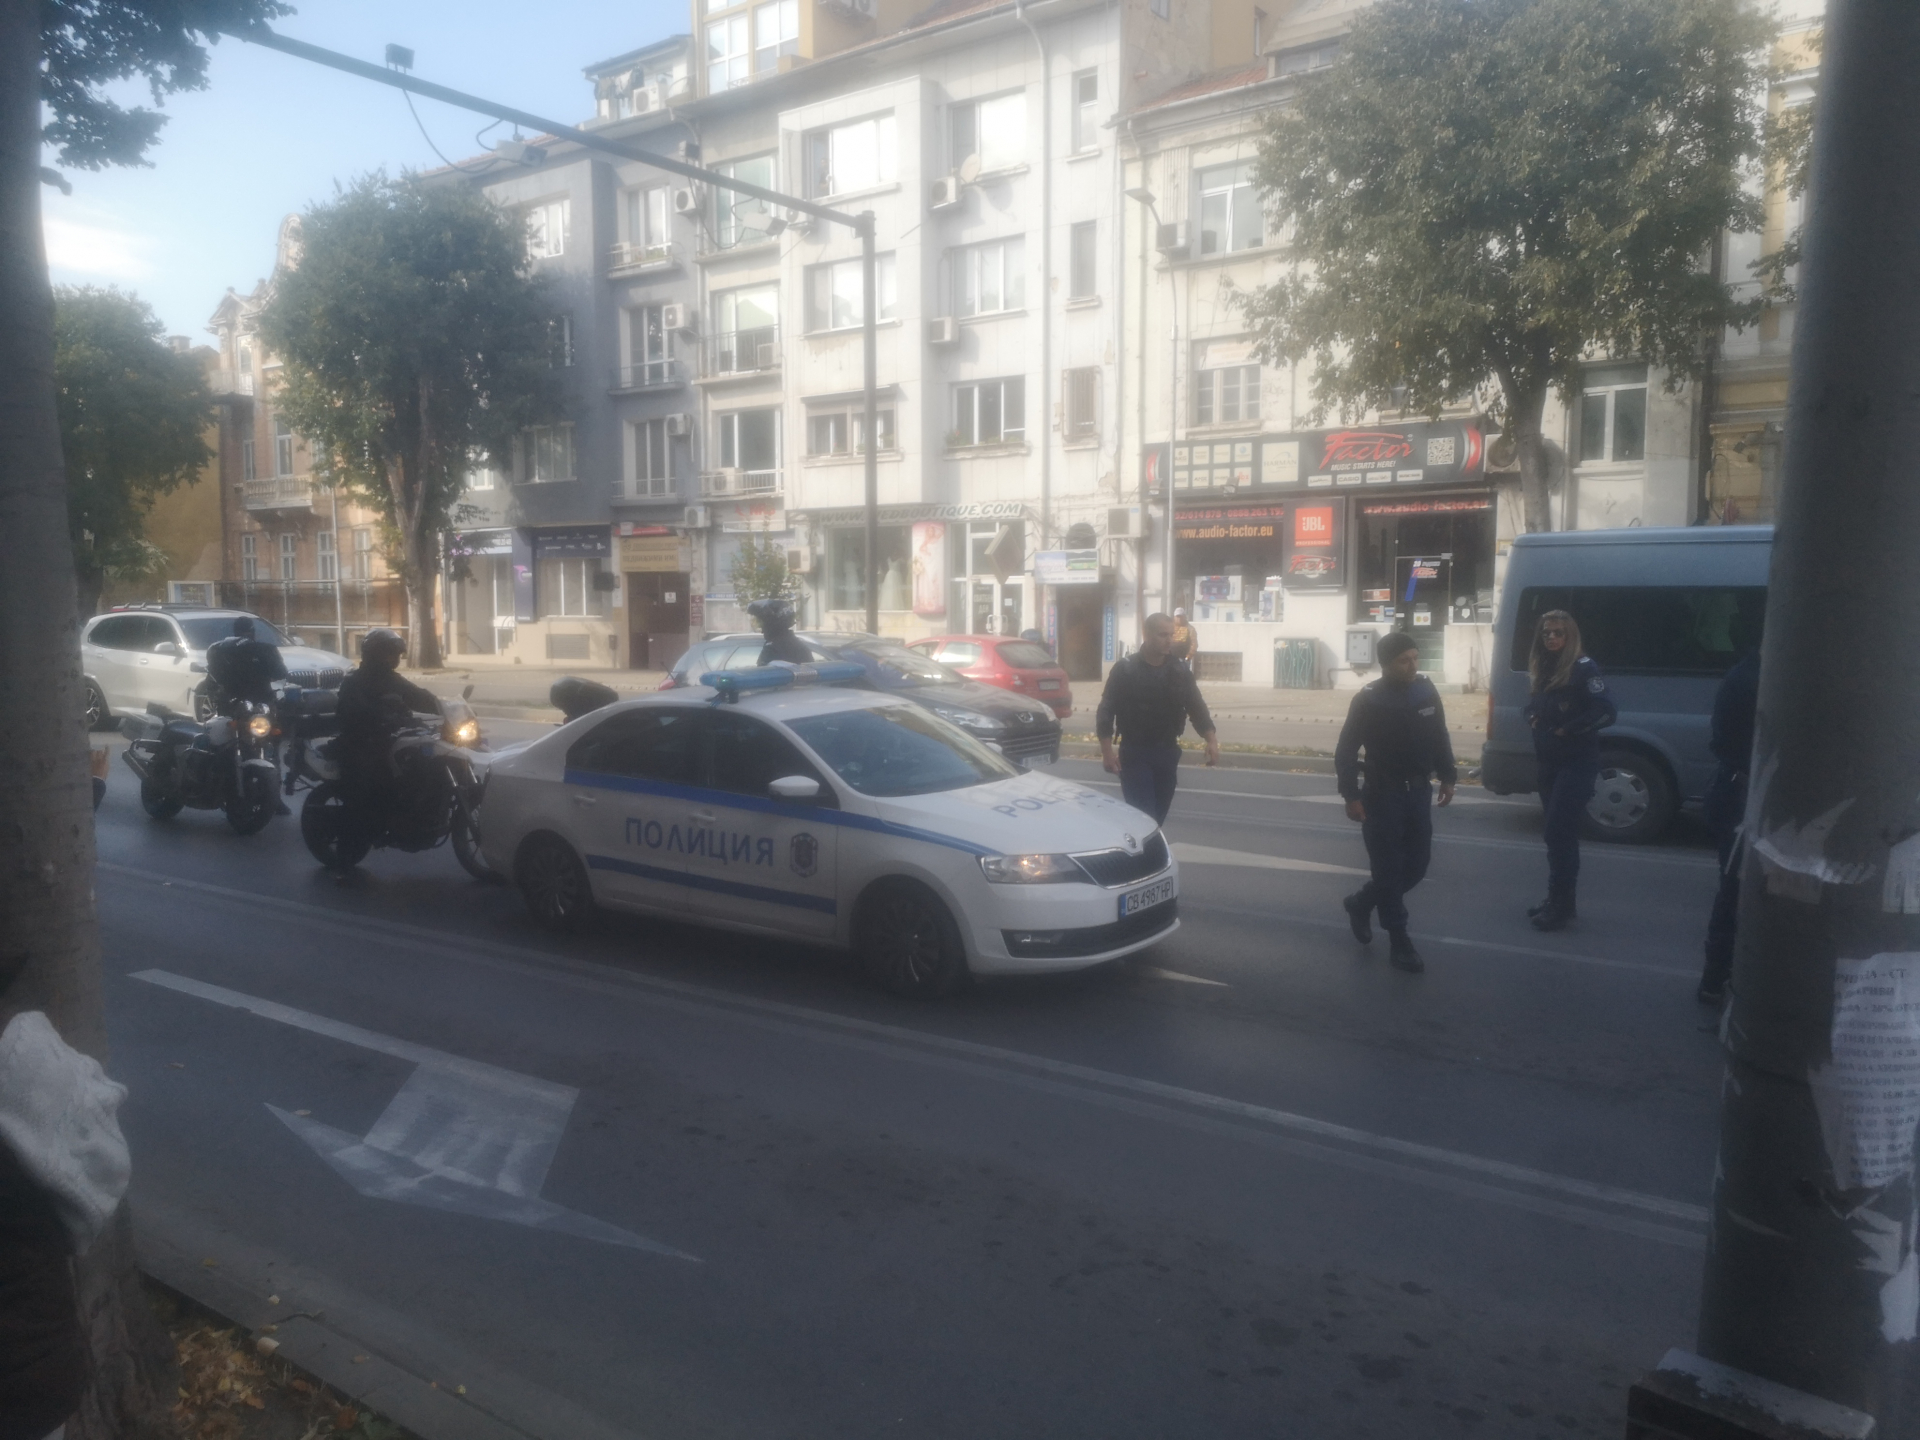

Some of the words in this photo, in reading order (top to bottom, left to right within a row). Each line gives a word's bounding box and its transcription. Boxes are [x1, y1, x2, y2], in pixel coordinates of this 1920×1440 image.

[1319, 431, 1415, 470] Factor
[1352, 462, 1376, 470] STARTS
[1377, 460, 1397, 468] HERE!
[821, 503, 1018, 522] WWW.EDBOUTIQUE.COM
[1302, 516, 1325, 531] JBL
[625, 816, 774, 867] ПОЛИЦИЯ
